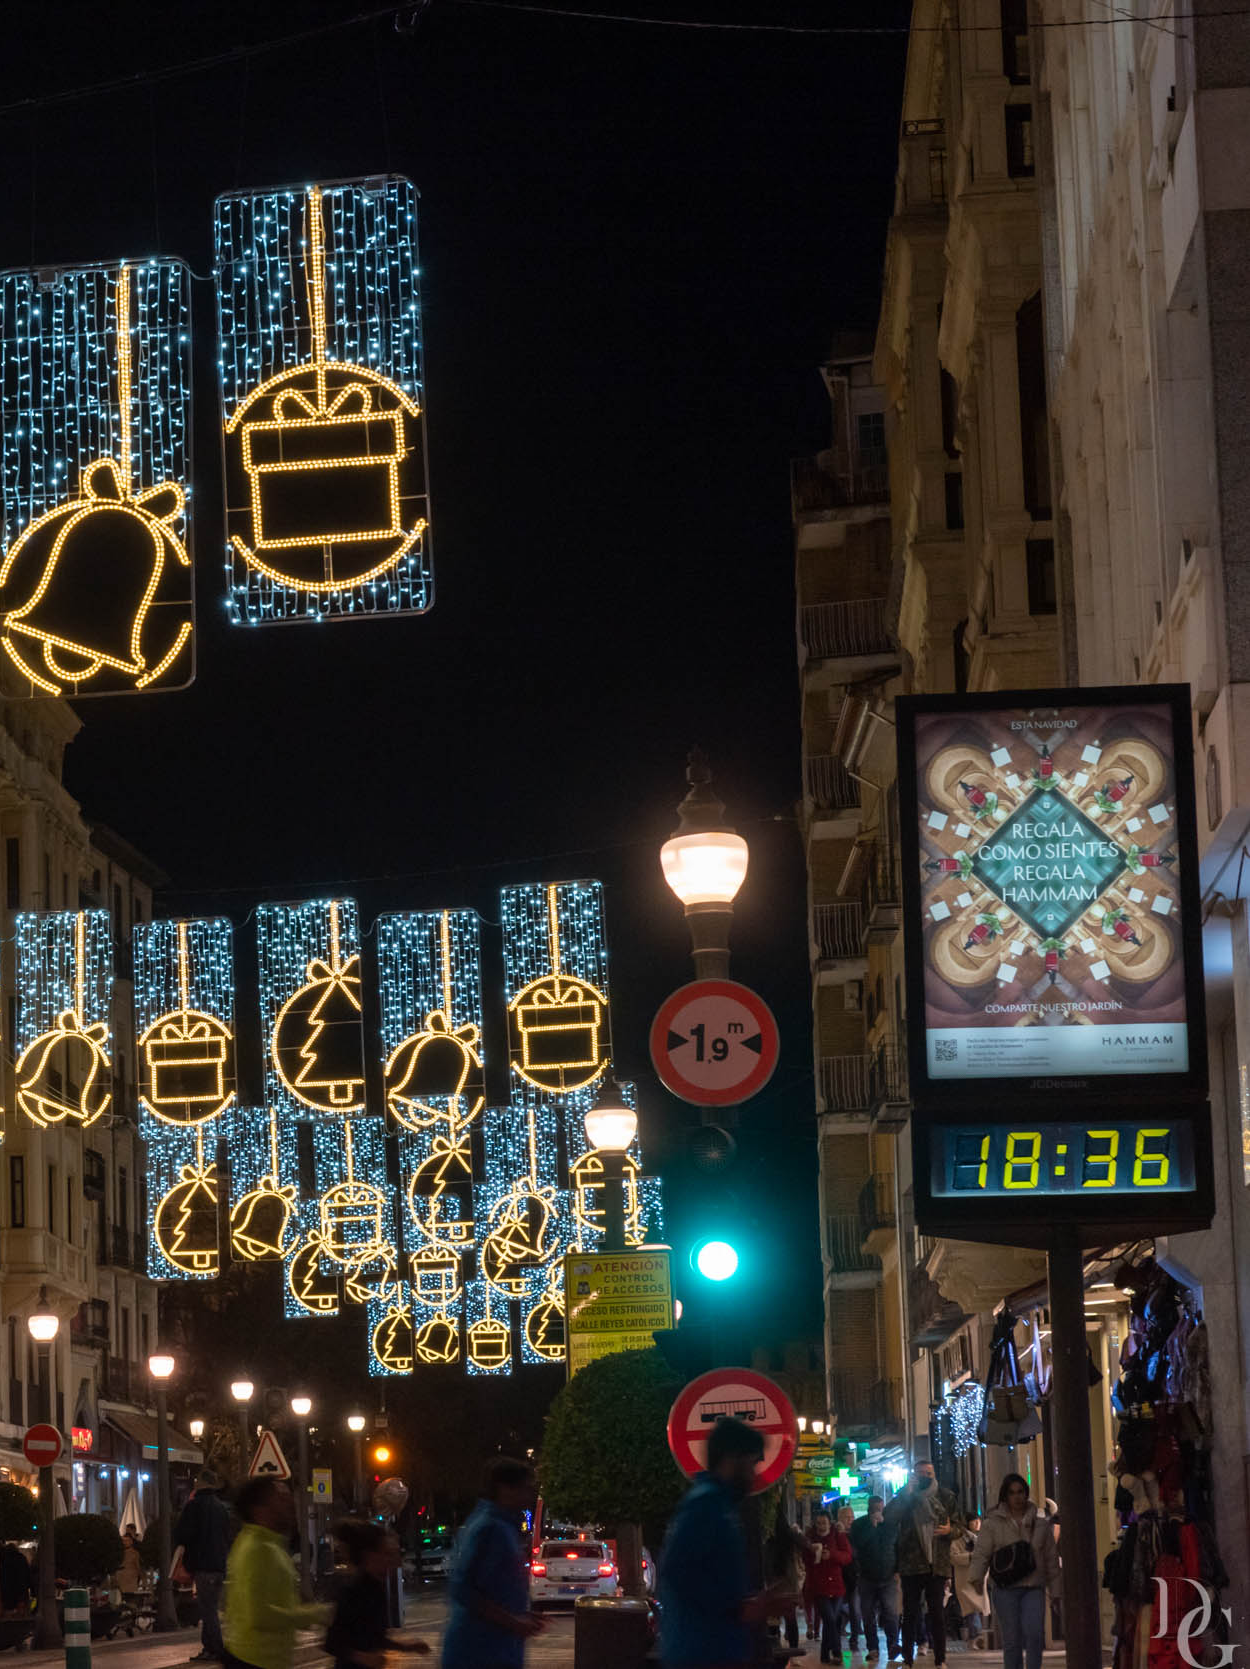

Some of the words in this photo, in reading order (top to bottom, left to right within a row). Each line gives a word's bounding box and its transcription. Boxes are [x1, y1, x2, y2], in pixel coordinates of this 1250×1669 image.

[1011, 720, 1033, 730] ESTA
[1034, 719, 1078, 729] NAVIDAD
[1012, 822, 1084, 839] REGALA
[978, 844, 1041, 861] COMO
[1045, 842, 1119, 859] SIENTES
[1013, 864, 1086, 881] REGALA
[1002, 885, 1098, 902] HAMMAM
[985, 1003, 1039, 1014] COMPARTE
[1040, 1001, 1087, 1012] NUESTRO
[1087, 999, 1123, 1012] JARDÍN
[1102, 1035, 1174, 1046] HAMMAM
[978, 1129, 1170, 1189] 18:36
[594, 1259, 664, 1273] ATENCIÓN
[603, 1273, 656, 1284] CONTROL
[597, 1286, 611, 1295] DE
[612, 1284, 665, 1295] ACCESOS
[610, 1304, 665, 1315] RESTRINGIDO
[575, 1320, 598, 1330] CALLE
[600, 1319, 624, 1329] REYES
[625, 1316, 666, 1327] CATÓLICOS
